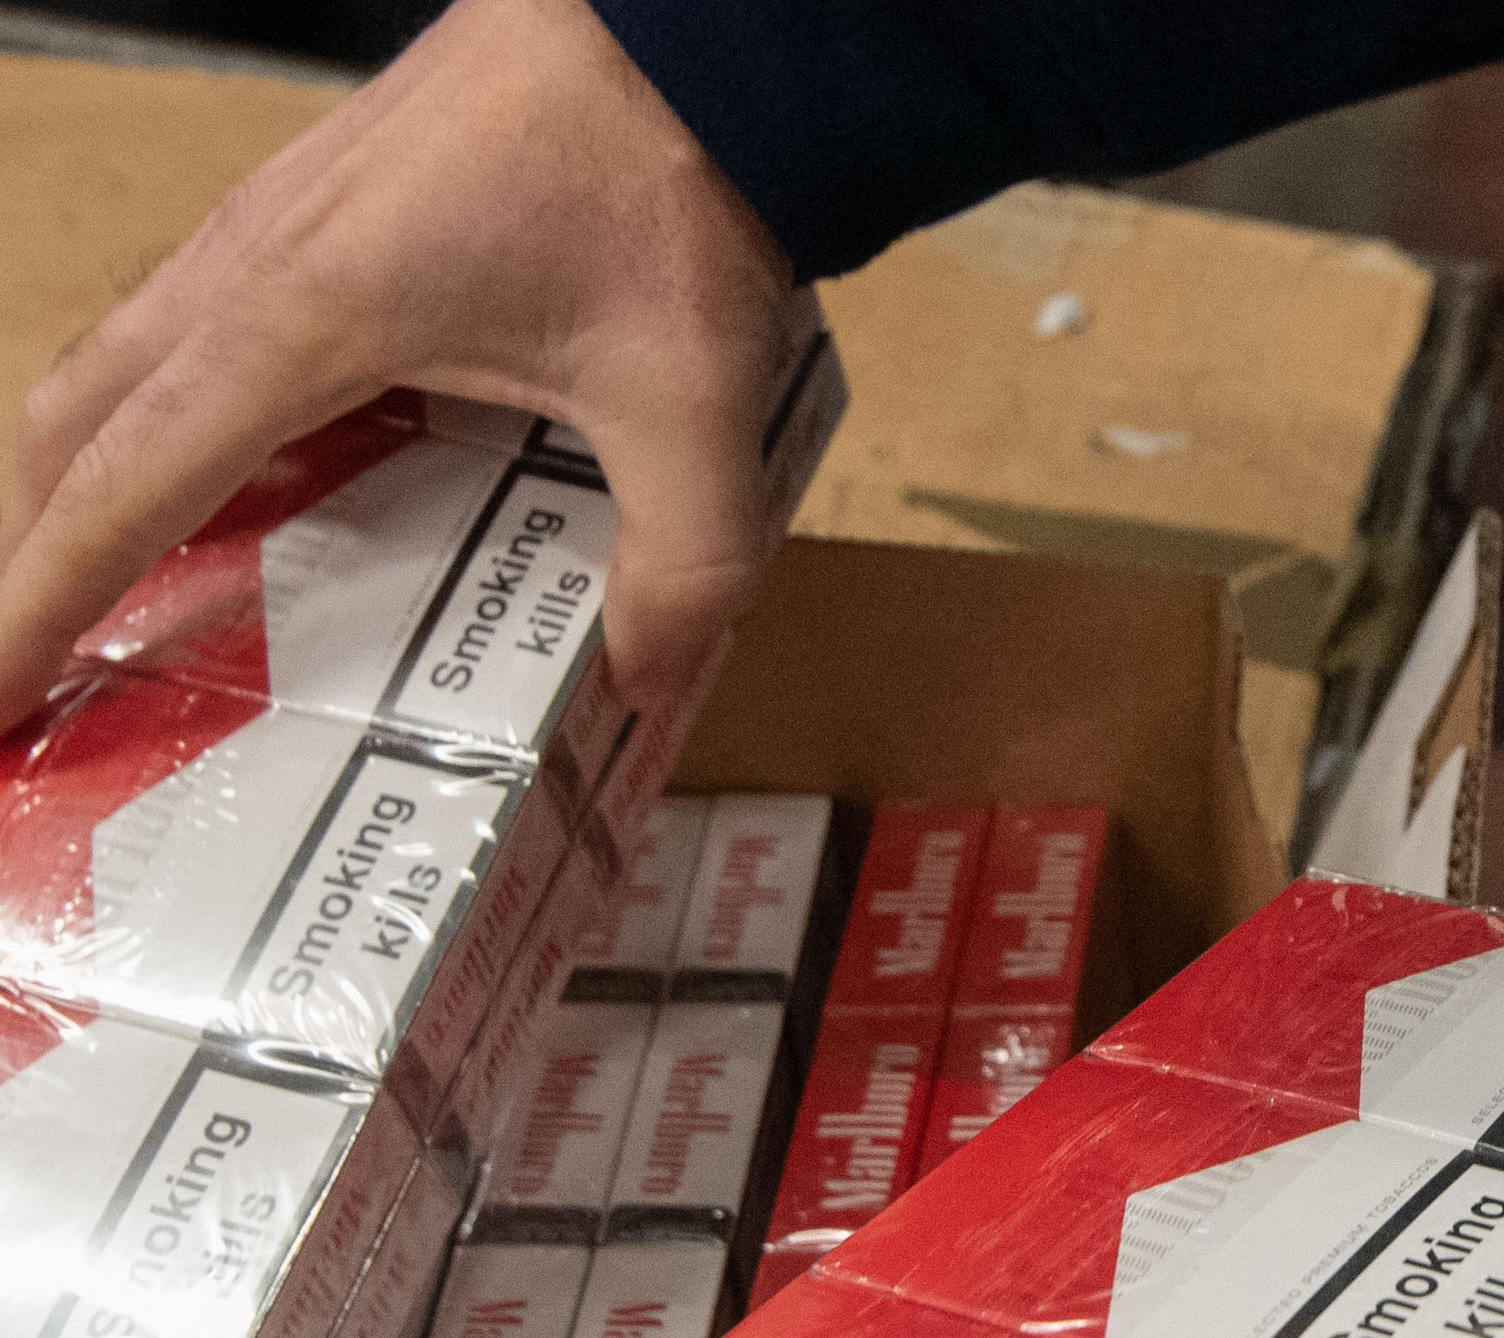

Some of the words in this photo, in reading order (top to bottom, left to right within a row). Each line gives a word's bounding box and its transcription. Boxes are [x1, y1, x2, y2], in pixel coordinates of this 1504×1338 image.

[430, 508, 566, 693] Smoking
[515, 569, 591, 658] kills
[267, 793, 417, 998] Smoking
[871, 832, 965, 978] Marlboro
[995, 833, 1087, 979] Marlboro
[642, 1054, 732, 1195] Marlboro
[815, 1044, 921, 1210] Marlboro
